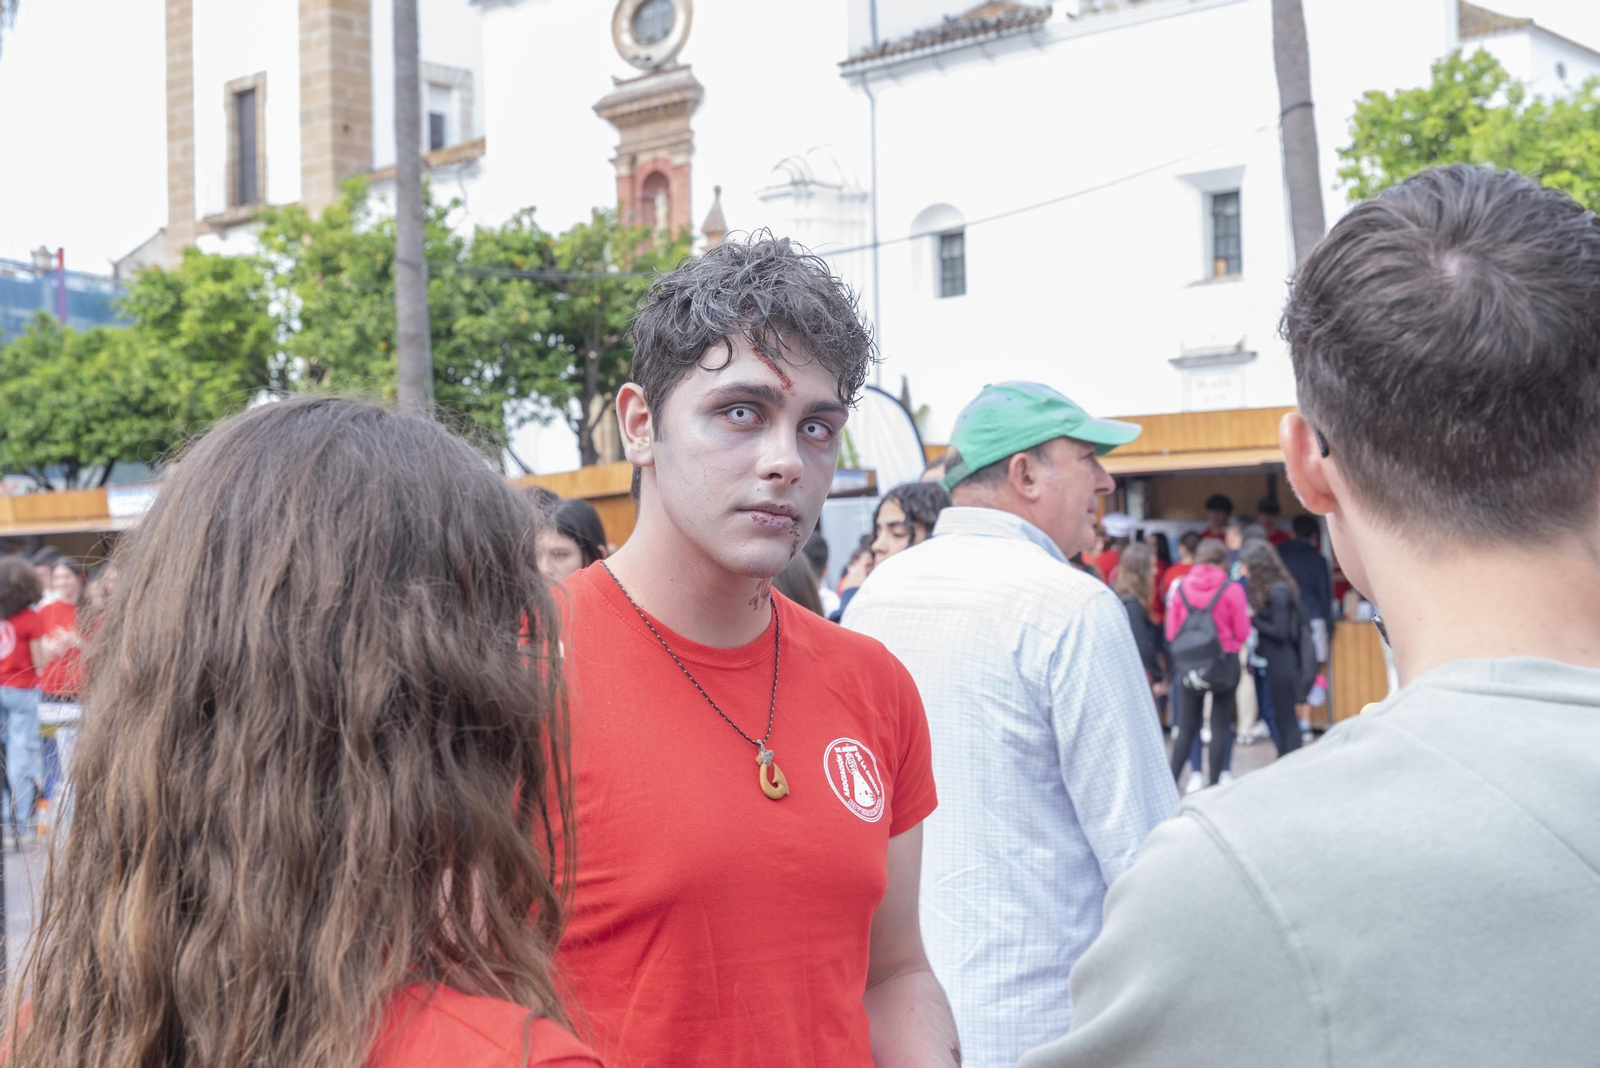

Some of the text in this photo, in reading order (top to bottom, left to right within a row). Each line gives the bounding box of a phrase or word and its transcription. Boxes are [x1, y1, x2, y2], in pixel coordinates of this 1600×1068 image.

[836, 753, 850, 798] ASOCIACIÓN
[854, 751, 863, 762] DE
[860, 760, 867, 770] LA
